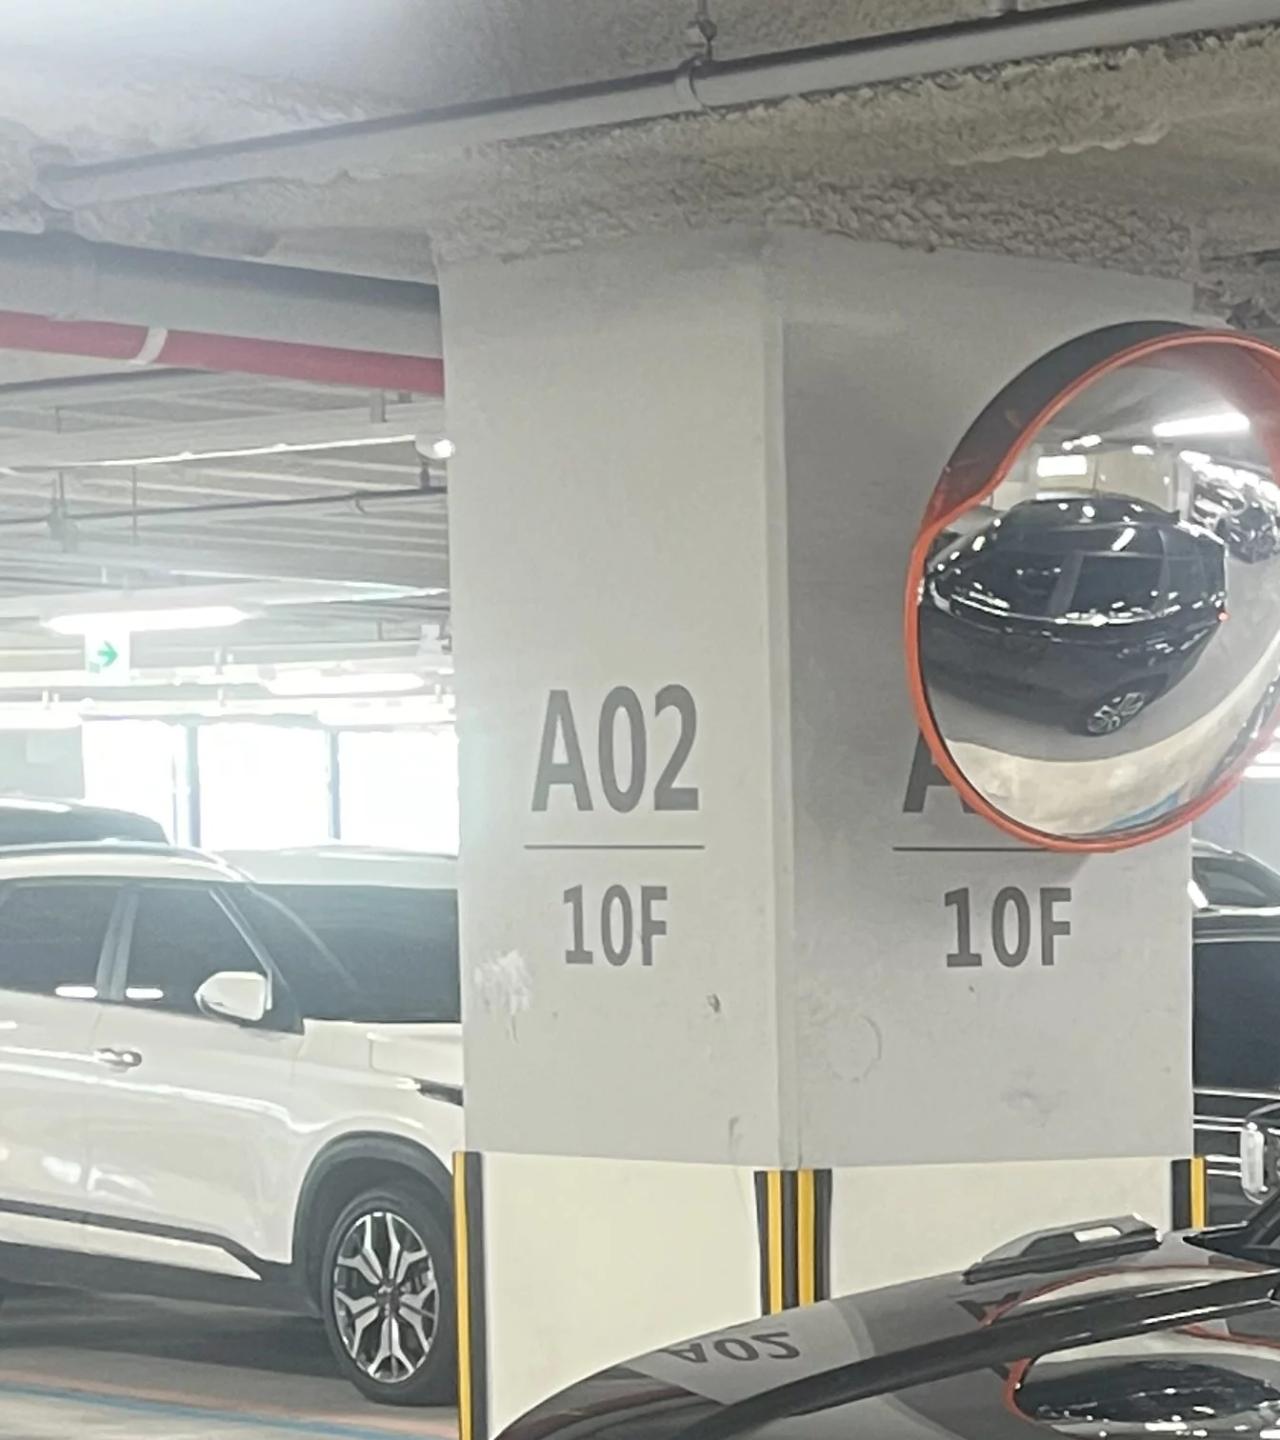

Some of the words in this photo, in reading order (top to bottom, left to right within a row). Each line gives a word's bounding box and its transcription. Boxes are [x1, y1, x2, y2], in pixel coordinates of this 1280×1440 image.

[531, 684, 699, 813] A02
[563, 884, 668, 967] 10F
[944, 886, 1072, 968] 10F
